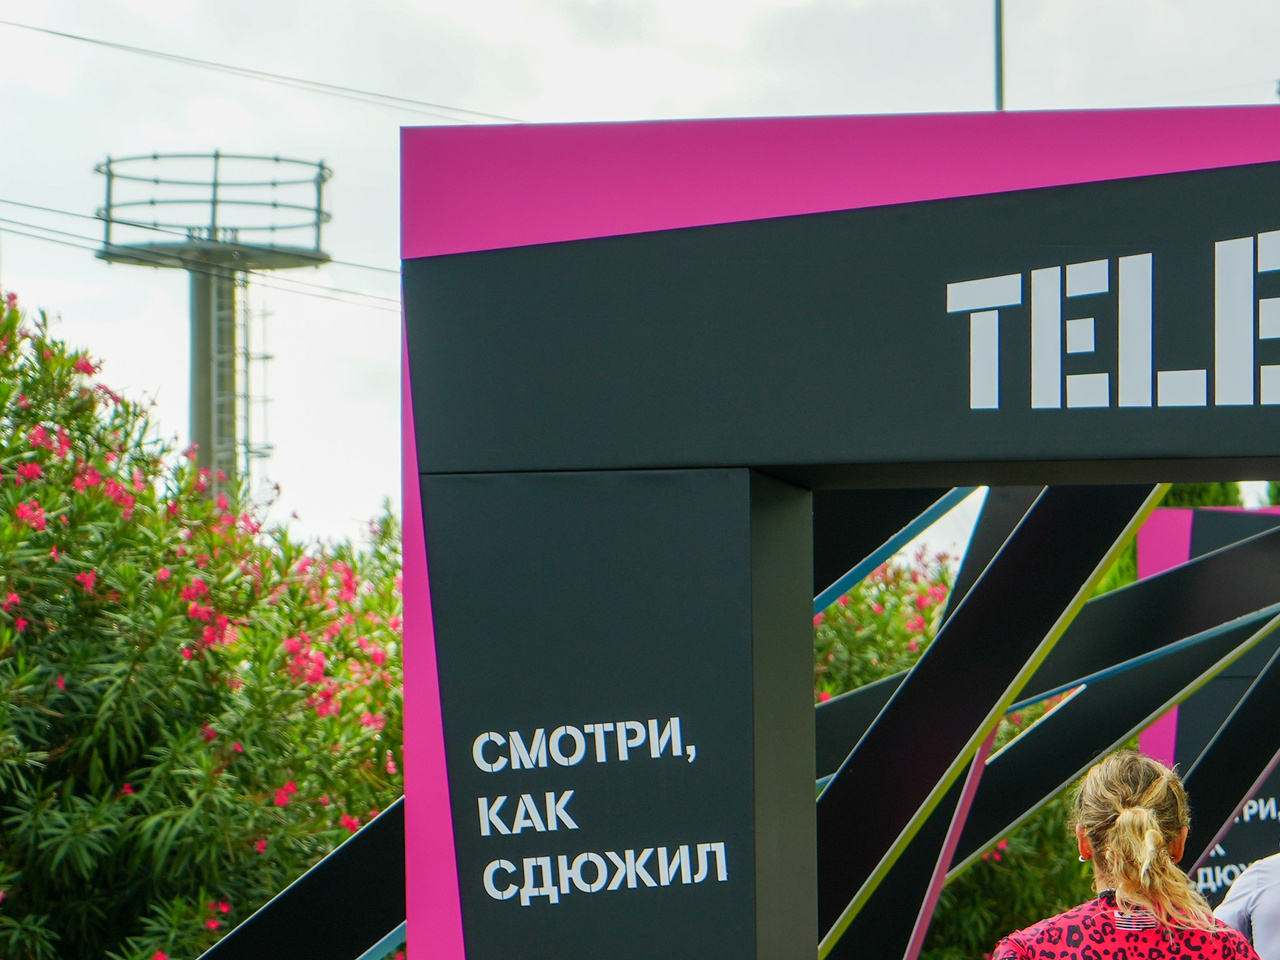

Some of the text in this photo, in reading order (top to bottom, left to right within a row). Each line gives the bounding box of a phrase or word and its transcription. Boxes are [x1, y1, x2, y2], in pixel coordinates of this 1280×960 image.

[472, 716, 697, 773] СМОТРИ,
[477, 789, 579, 837] КАК
[482, 842, 729, 906] СДЮЖИЛ
